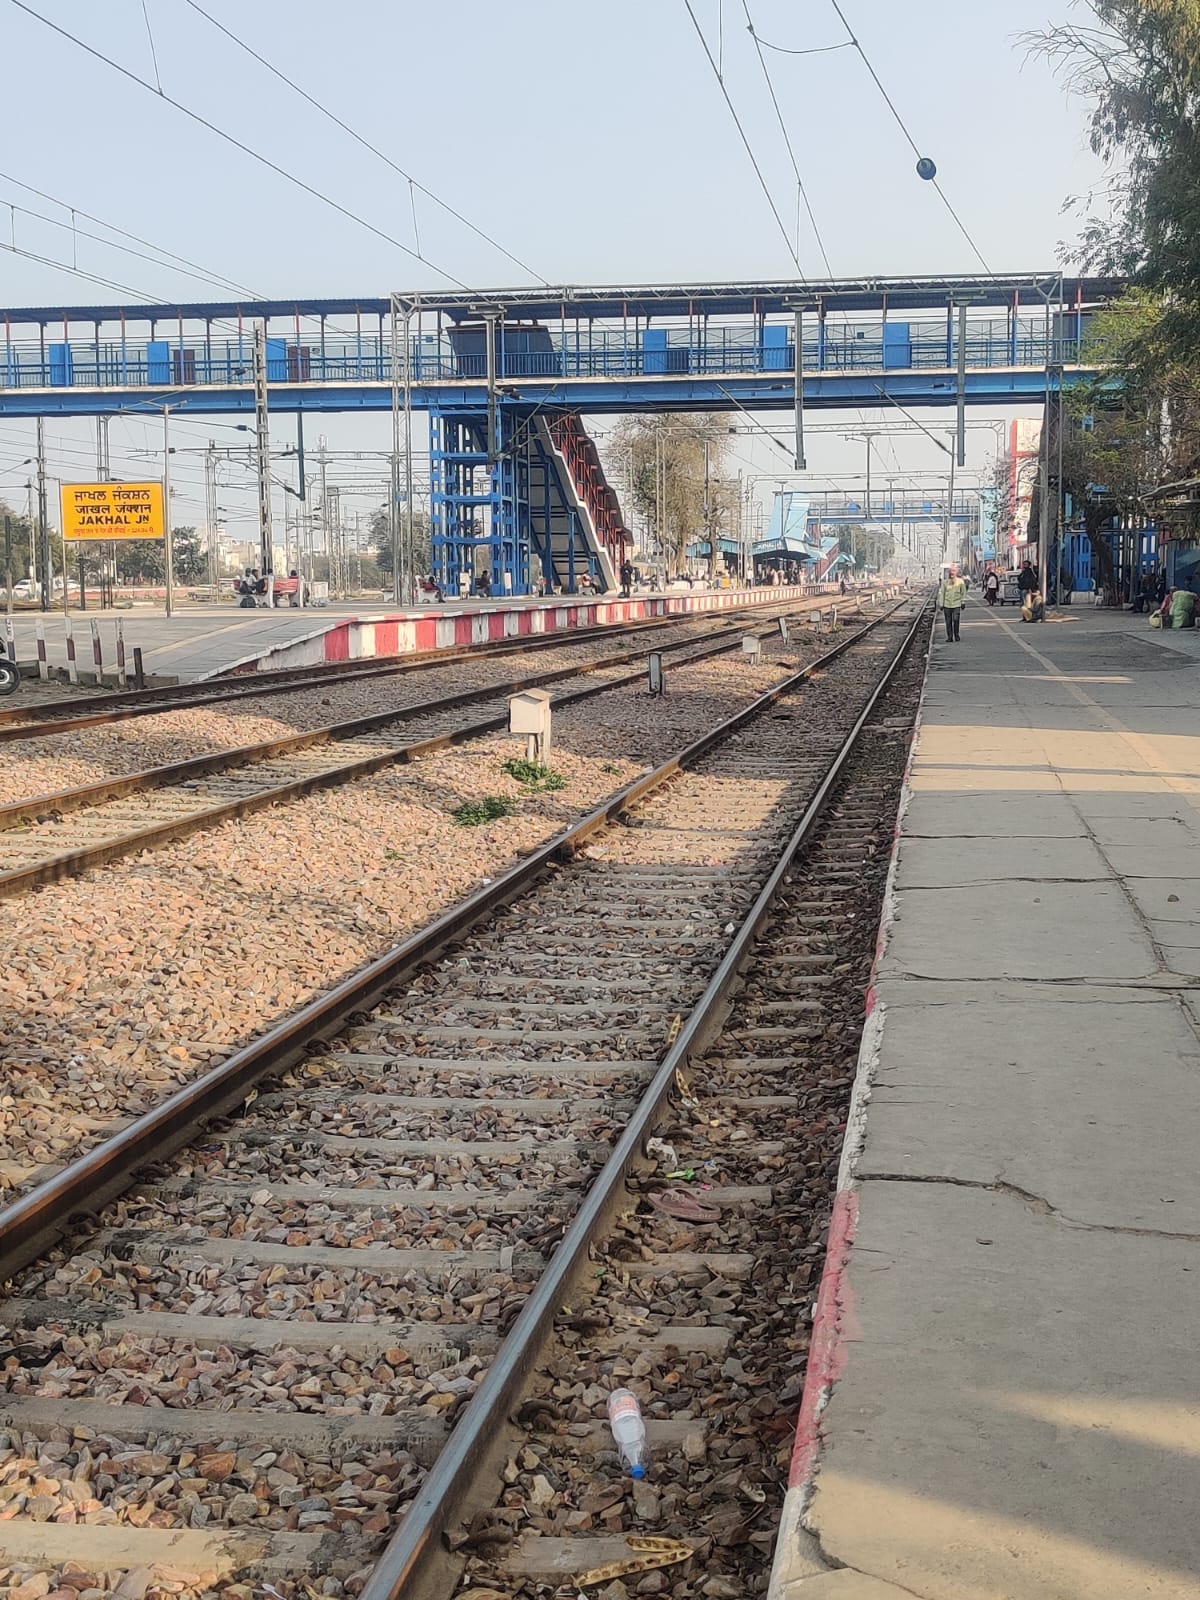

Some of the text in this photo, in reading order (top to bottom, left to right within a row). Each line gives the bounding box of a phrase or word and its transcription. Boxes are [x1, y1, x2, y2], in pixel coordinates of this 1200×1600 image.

[73, 491, 106, 501] ਜਾਖਲ
[74, 504, 110, 514] जाखल
[78, 515, 131, 525] JAKHAL
